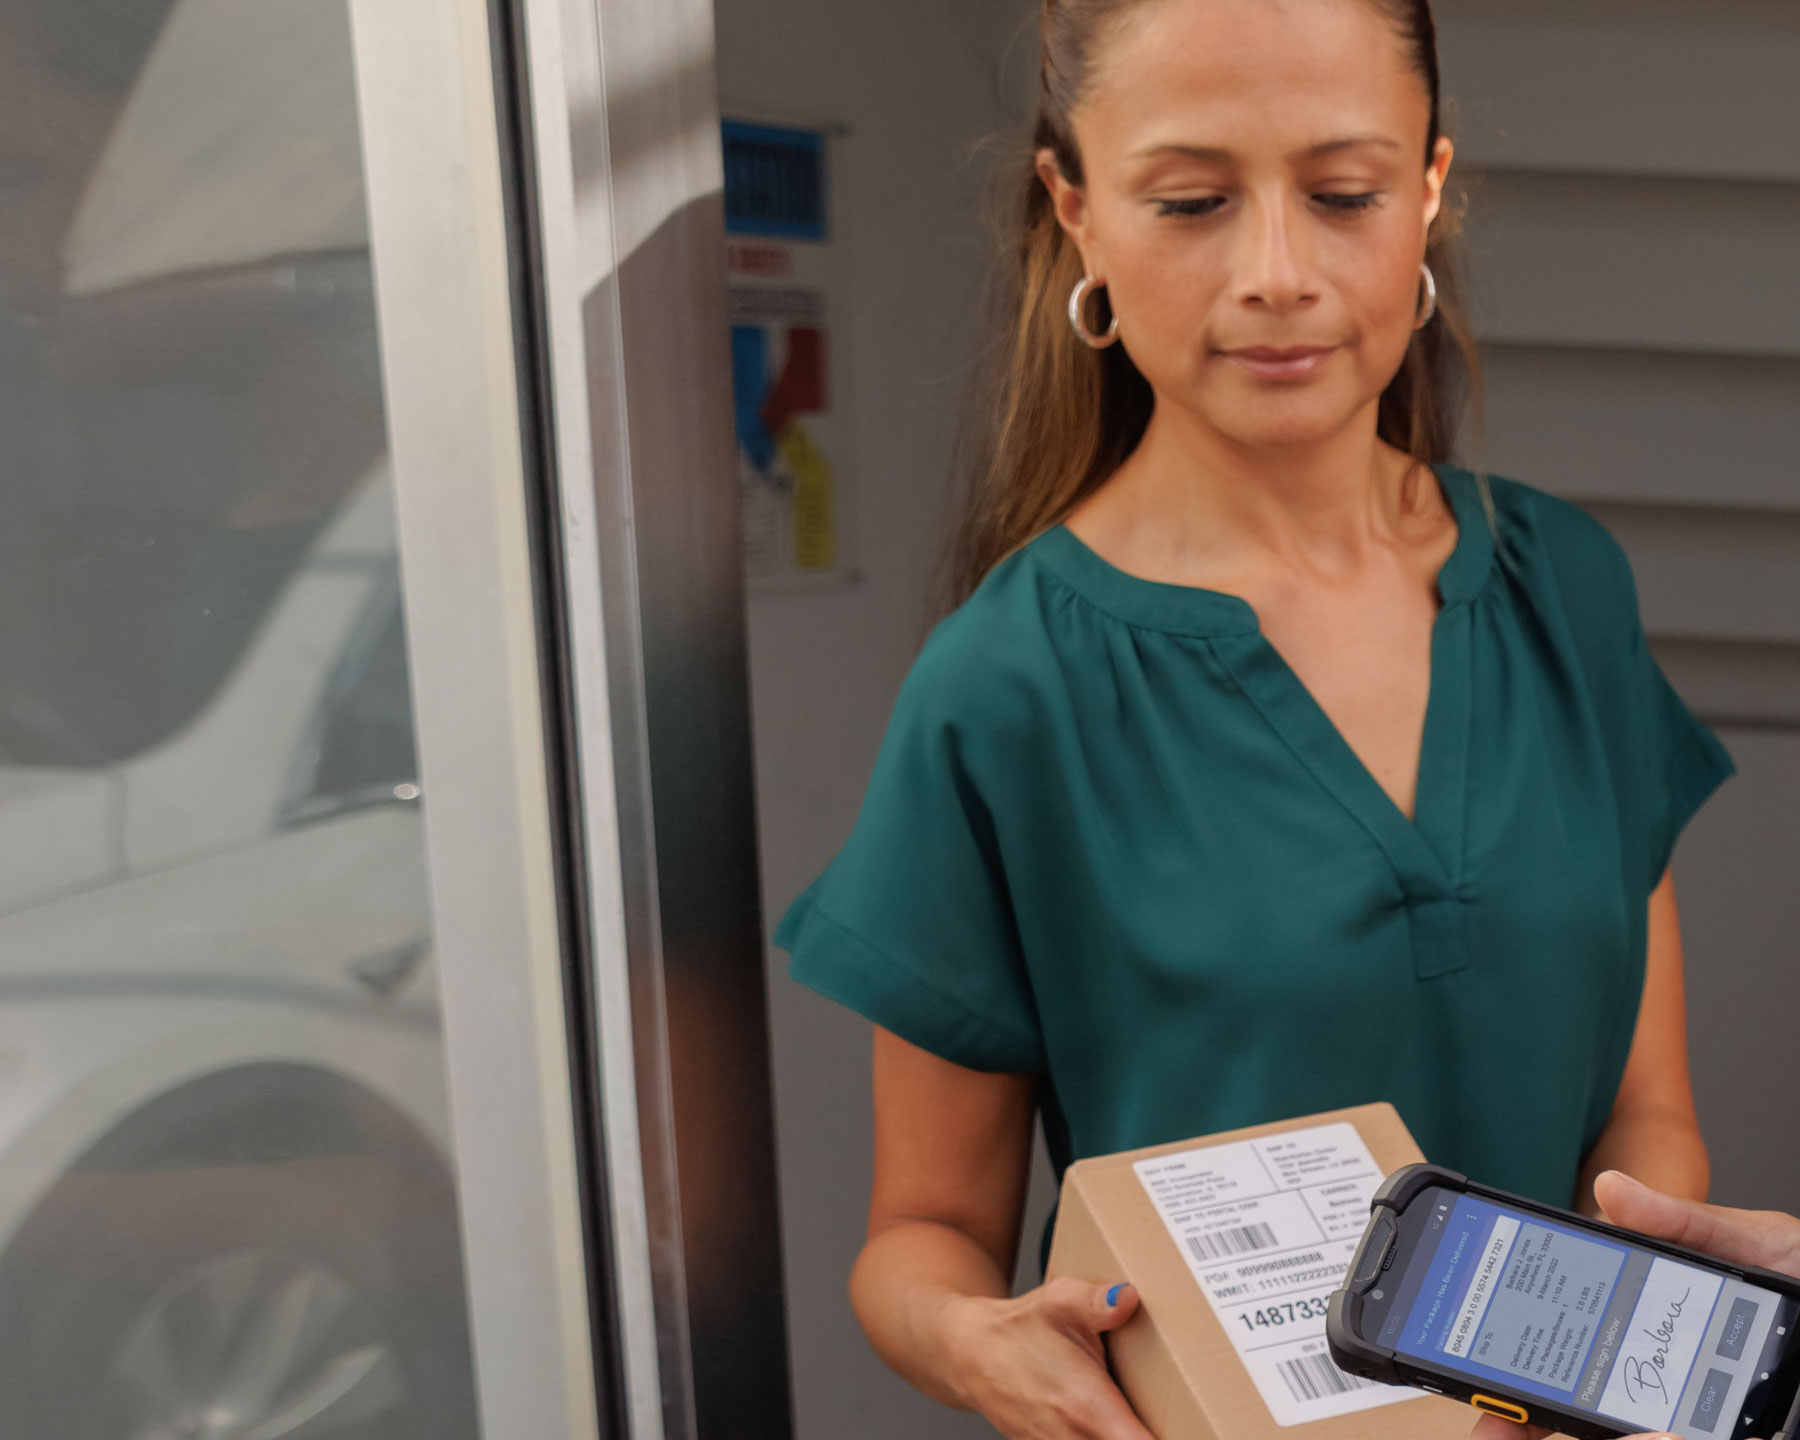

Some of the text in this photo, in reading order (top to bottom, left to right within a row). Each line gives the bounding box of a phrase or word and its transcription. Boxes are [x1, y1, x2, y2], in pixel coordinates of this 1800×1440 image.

[1505, 1265, 1521, 1289] Barbara
[1519, 1239, 1531, 1258] Jones
[1515, 1279, 1525, 1292] 200
[1520, 1263, 1531, 1279] Main
[1524, 1232, 1554, 1295] Anywhere, FL 33000
[1416, 1231, 1469, 1345] Your Package Has Been Delivered
[1452, 1238, 1504, 1353] 8045 0804 3 0 00 5574 5442 7321
[1576, 1300, 1585, 1311] 2.0
[1580, 1286, 1591, 1301] LBS
[1510, 1258, 1559, 1367] Delivery Date: 9-March 2022
[1522, 1345, 1539, 1370] Delivery
[1551, 1286, 1563, 1303] 11:10
[1558, 1275, 1567, 1287] AM
[1726, 1314, 1745, 1347] Accept
[1478, 1341, 1490, 1356] Ship
[1548, 1351, 1564, 1379] Package
[1561, 1350, 1579, 1383] Reference
[1623, 1287, 1691, 1405] Barbara
[1581, 1369, 1601, 1402] Please
[1596, 1348, 1610, 1368] sign
[1700, 1386, 1716, 1412] Clear
